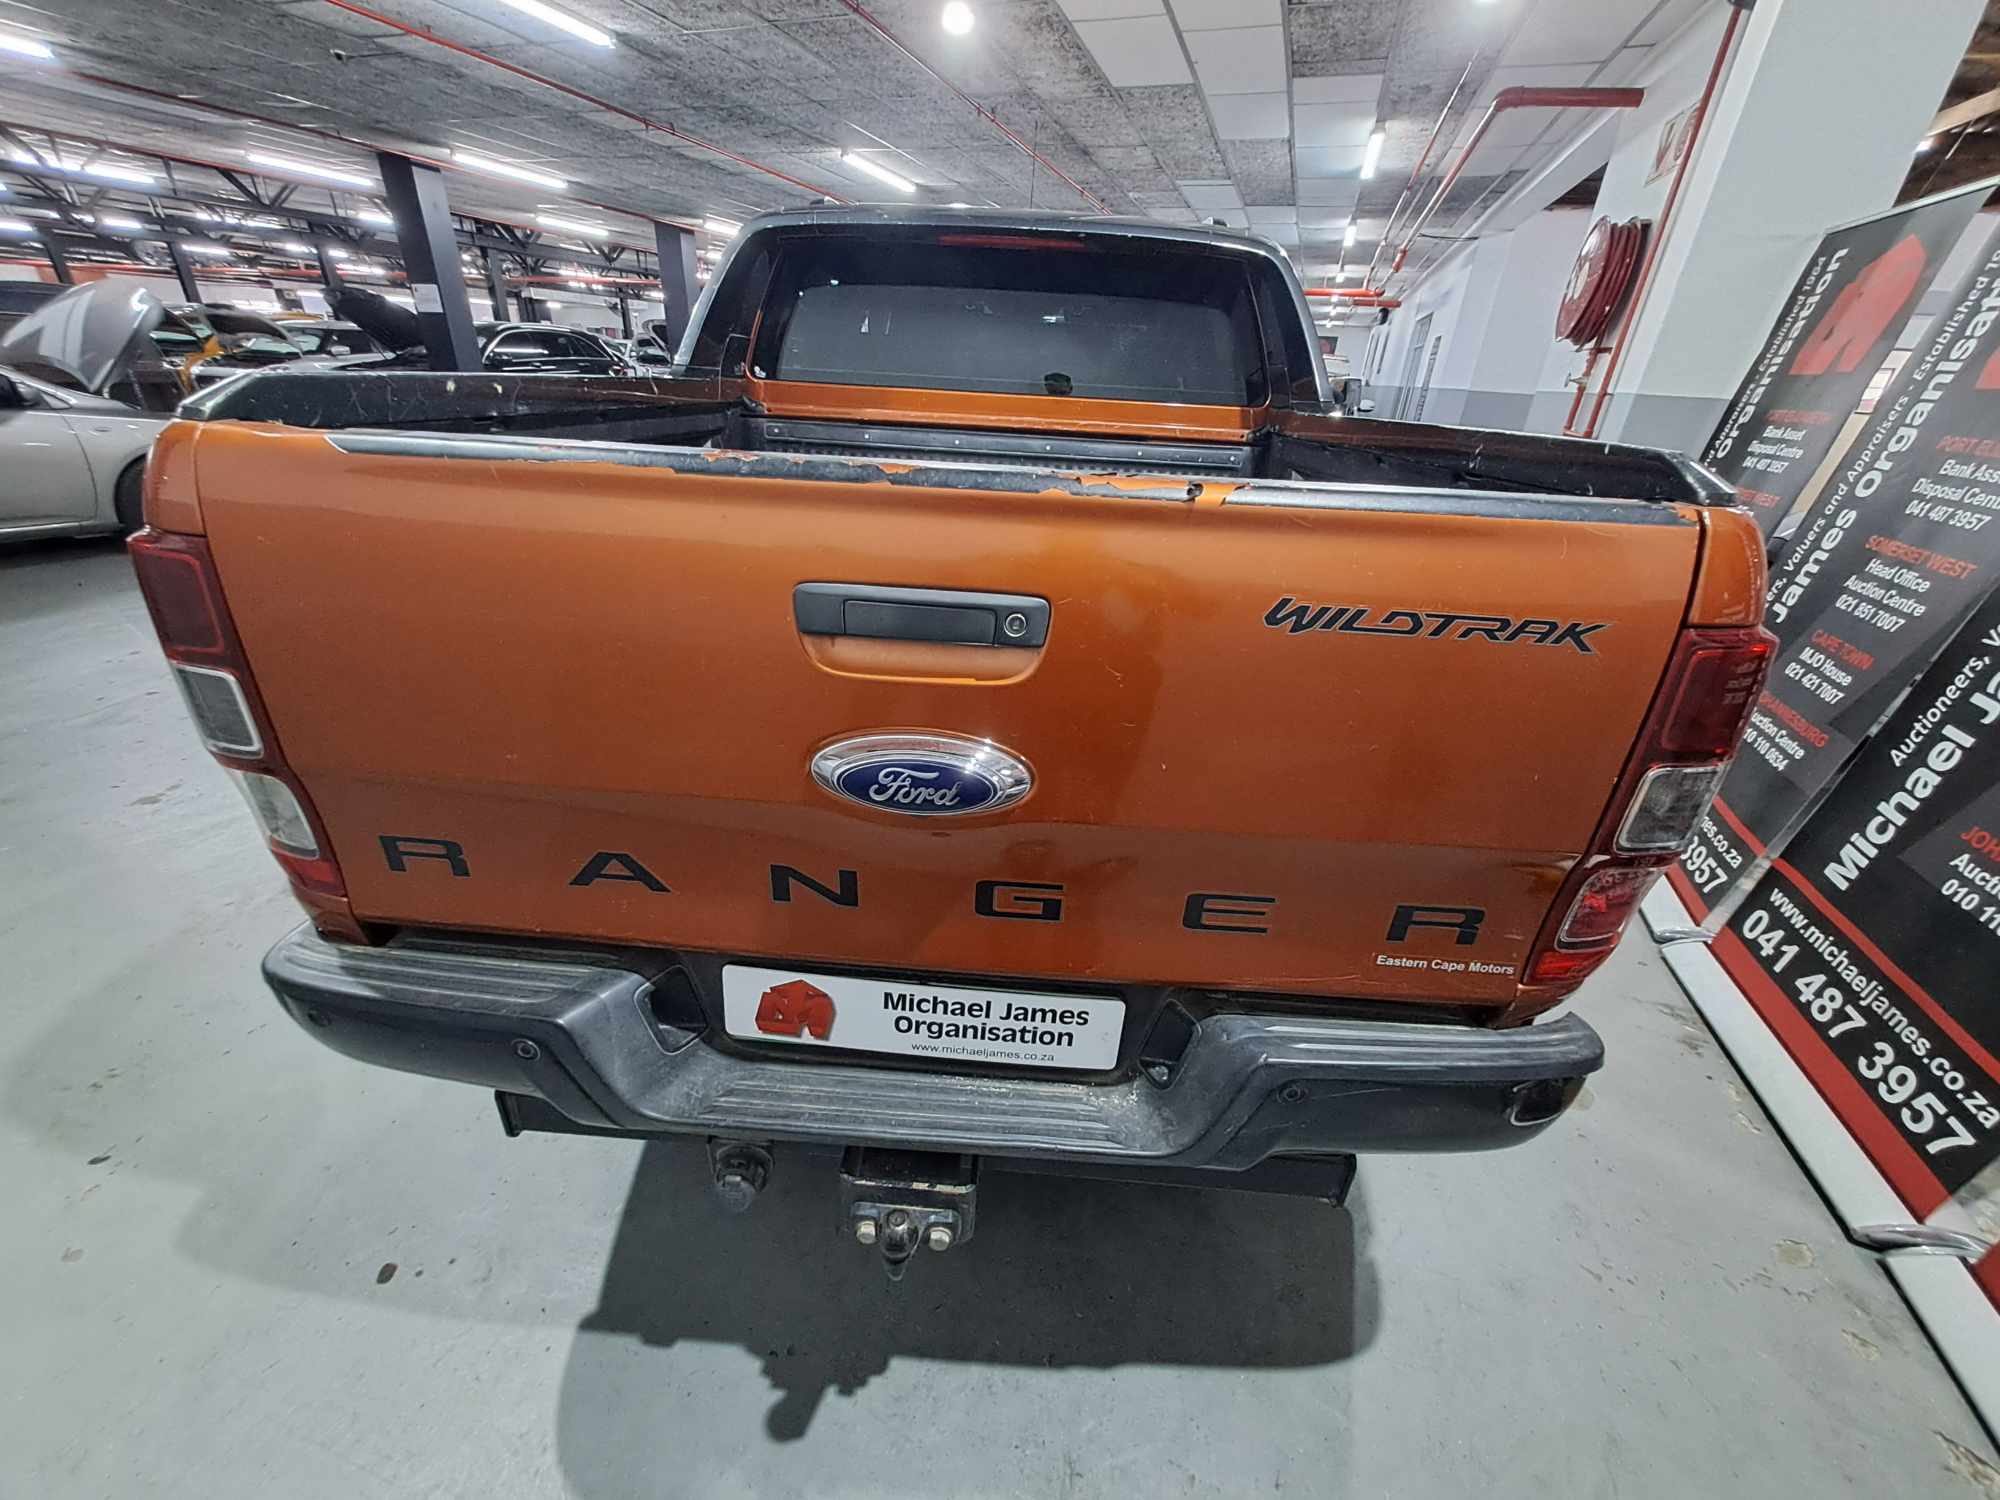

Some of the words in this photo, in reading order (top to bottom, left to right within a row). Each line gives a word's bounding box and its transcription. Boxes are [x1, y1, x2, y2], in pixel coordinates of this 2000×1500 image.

[1716, 248, 1850, 459] Organisation
[1784, 517, 1826, 572] Valuers
[1824, 482, 1848, 515] and
[1847, 396, 1909, 483] Appraisers
[1913, 277, 1990, 381] Established
[1772, 509, 1857, 624] James
[1855, 278, 2000, 497] Organisat
[1912, 478, 1969, 501] Disposal
[1939, 459, 1977, 478] Bank
[1970, 464, 2000, 484] Ass
[1905, 500, 1932, 518] 041
[1928, 505, 1954, 522] 487
[1950, 510, 1992, 531] 3957
[1865, 559, 1900, 580] Head
[1893, 567, 1931, 593] Office
[1835, 594, 1859, 612] 021
[1853, 602, 1876, 623] 851
[1871, 610, 1906, 632] 7007
[1843, 575, 1886, 601] Auction
[1882, 590, 1928, 617] Centre
[1263, 595, 1611, 654] WILDTRAK
[1784, 662, 1806, 681] 021
[1801, 672, 1822, 690] 421
[1816, 682, 1846, 704] 7007
[1820, 659, 1853, 686] House
[1890, 656, 1991, 768] Auctioneers,
[1743, 728, 1758, 743] 10
[1775, 730, 1805, 759] Centre
[868, 767, 961, 806] Ford
[1824, 724, 1976, 891] Michael
[379, 835, 1486, 945] RANGER
[1941, 879, 1980, 911] 010
[1980, 906, 2000, 937] 11
[1376, 955, 1428, 969] Eastern
[1431, 959, 1466, 973] Cape
[1468, 962, 1515, 975] Motors
[883, 991, 992, 1020] Michael
[999, 1003, 1090, 1026] James
[1769, 887, 2000, 1129] www.michaeljames.co.za
[894, 1015, 1074, 1047] Organisation
[1742, 909, 1800, 973] 041
[1794, 973, 1868, 1038] 487
[1857, 1041, 1976, 1154] 3957
[911, 1042, 1055, 1063] www.michaeljames.co.za
